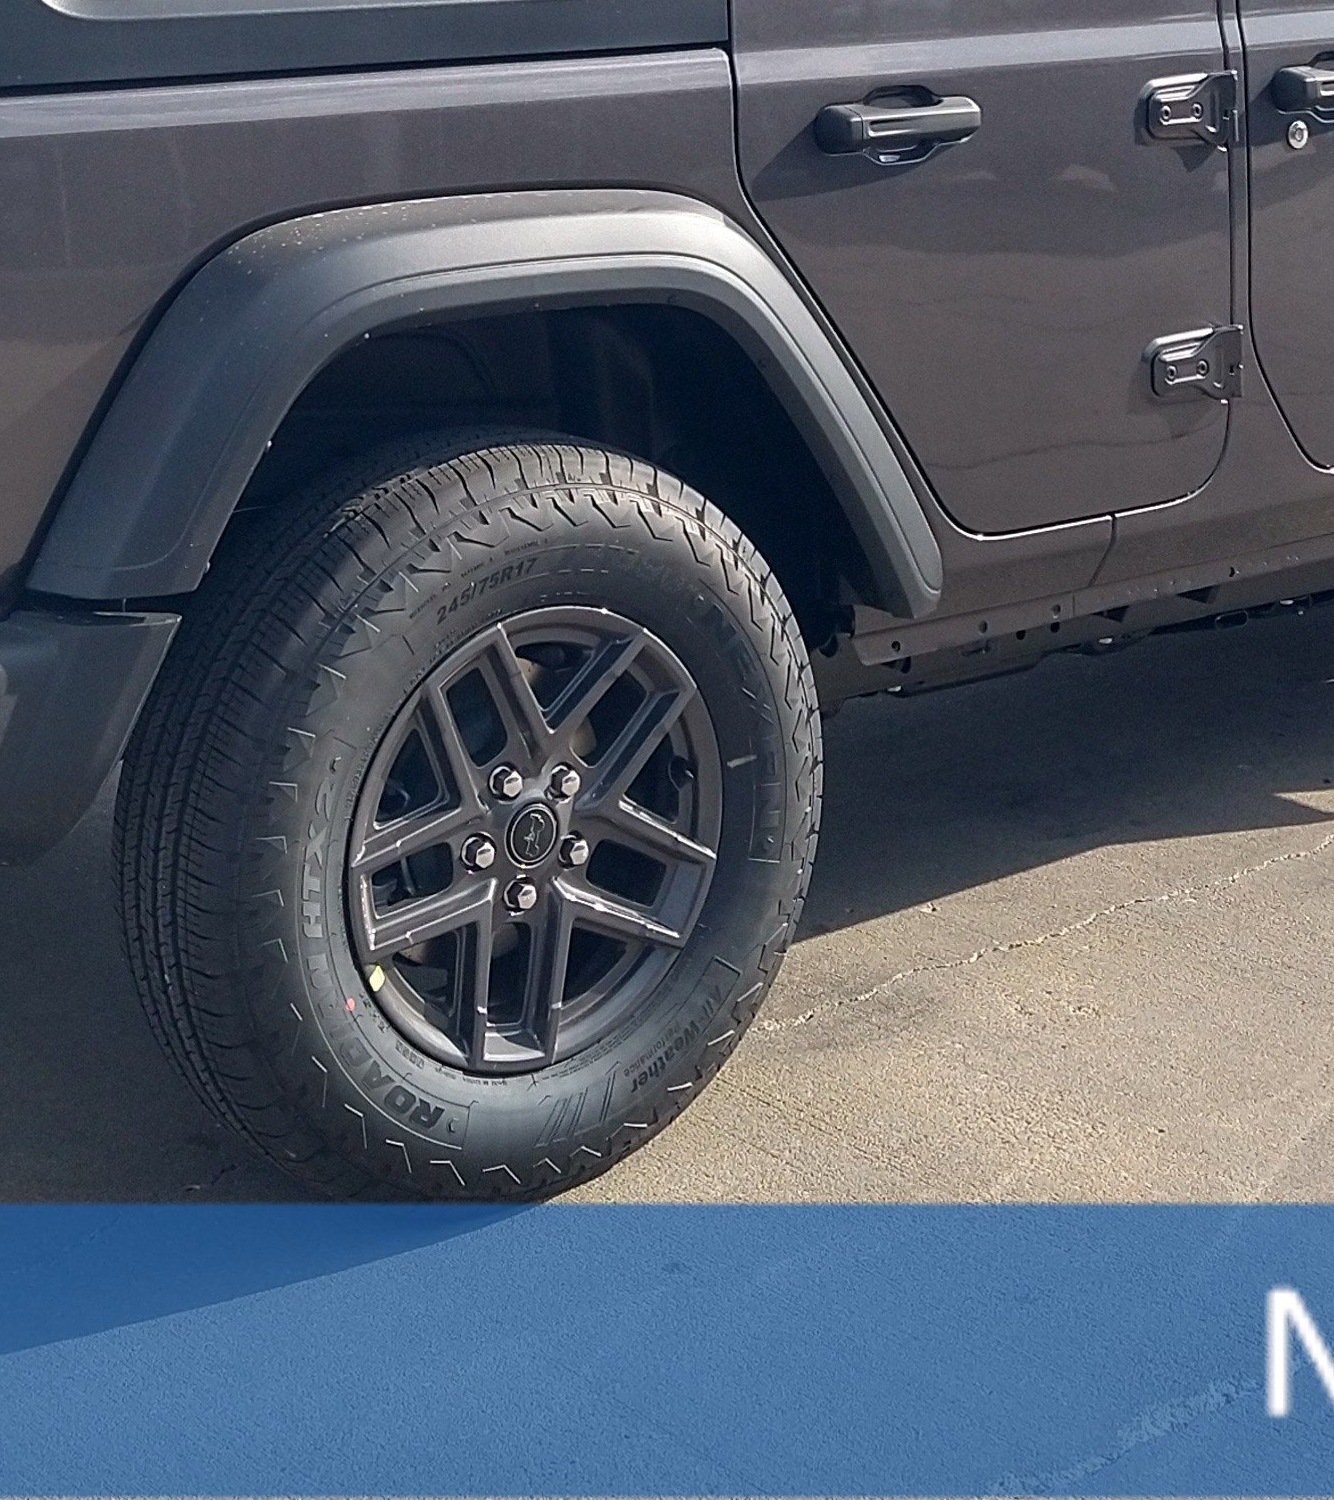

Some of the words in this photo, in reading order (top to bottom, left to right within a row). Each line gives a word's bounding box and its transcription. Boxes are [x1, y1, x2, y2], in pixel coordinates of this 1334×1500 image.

[432, 557, 537, 625] 245/75R17
[305, 949, 445, 1133] ROADIAN
[627, 984, 726, 1095] All-Weather
